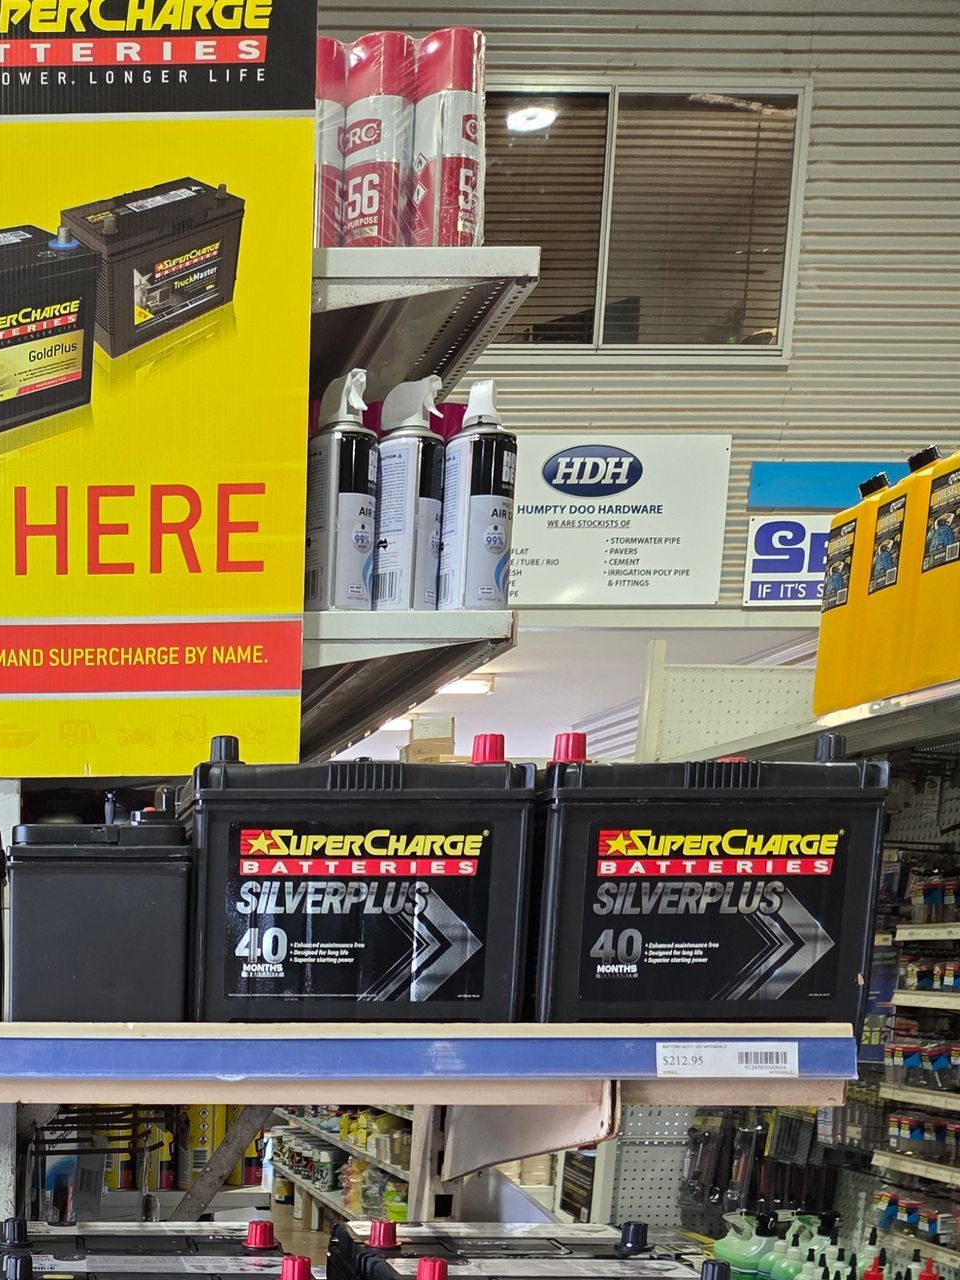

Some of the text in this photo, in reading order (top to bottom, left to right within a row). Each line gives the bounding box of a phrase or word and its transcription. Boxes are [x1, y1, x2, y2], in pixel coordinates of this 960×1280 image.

[90, 70, 189, 84] LONGER
[209, 68, 265, 82] LIFE
[29, 342, 77, 362] GoldPlus
[551, 457, 632, 487] HDH
[491, 509, 506, 519] AIR
[517, 504, 663, 515] HUMPTY DOO HARDWARE
[14, 482, 266, 576] HERE
[621, 520, 631, 528] OF
[615, 579, 649, 587] FITTINGS
[757, 583, 806, 598] IF IT'S
[49, 647, 180, 666] SUPERCHARGE
[185, 646, 207, 664] BY
[212, 645, 269, 664] NAME.
[268, 830, 482, 856] SUPERCHARGE
[628, 830, 838, 856] SUPERCHARGE
[243, 861, 474, 874] BATTERIES
[600, 860, 828, 874] BATTERIES
[237, 881, 429, 914] SILVERPLUS
[593, 881, 783, 915] SILVERPLUS
[235, 927, 287, 962] 40
[590, 929, 643, 964] 40
[597, 965, 637, 973] MONTHS
[663, 1055, 704, 1066] $212.95
